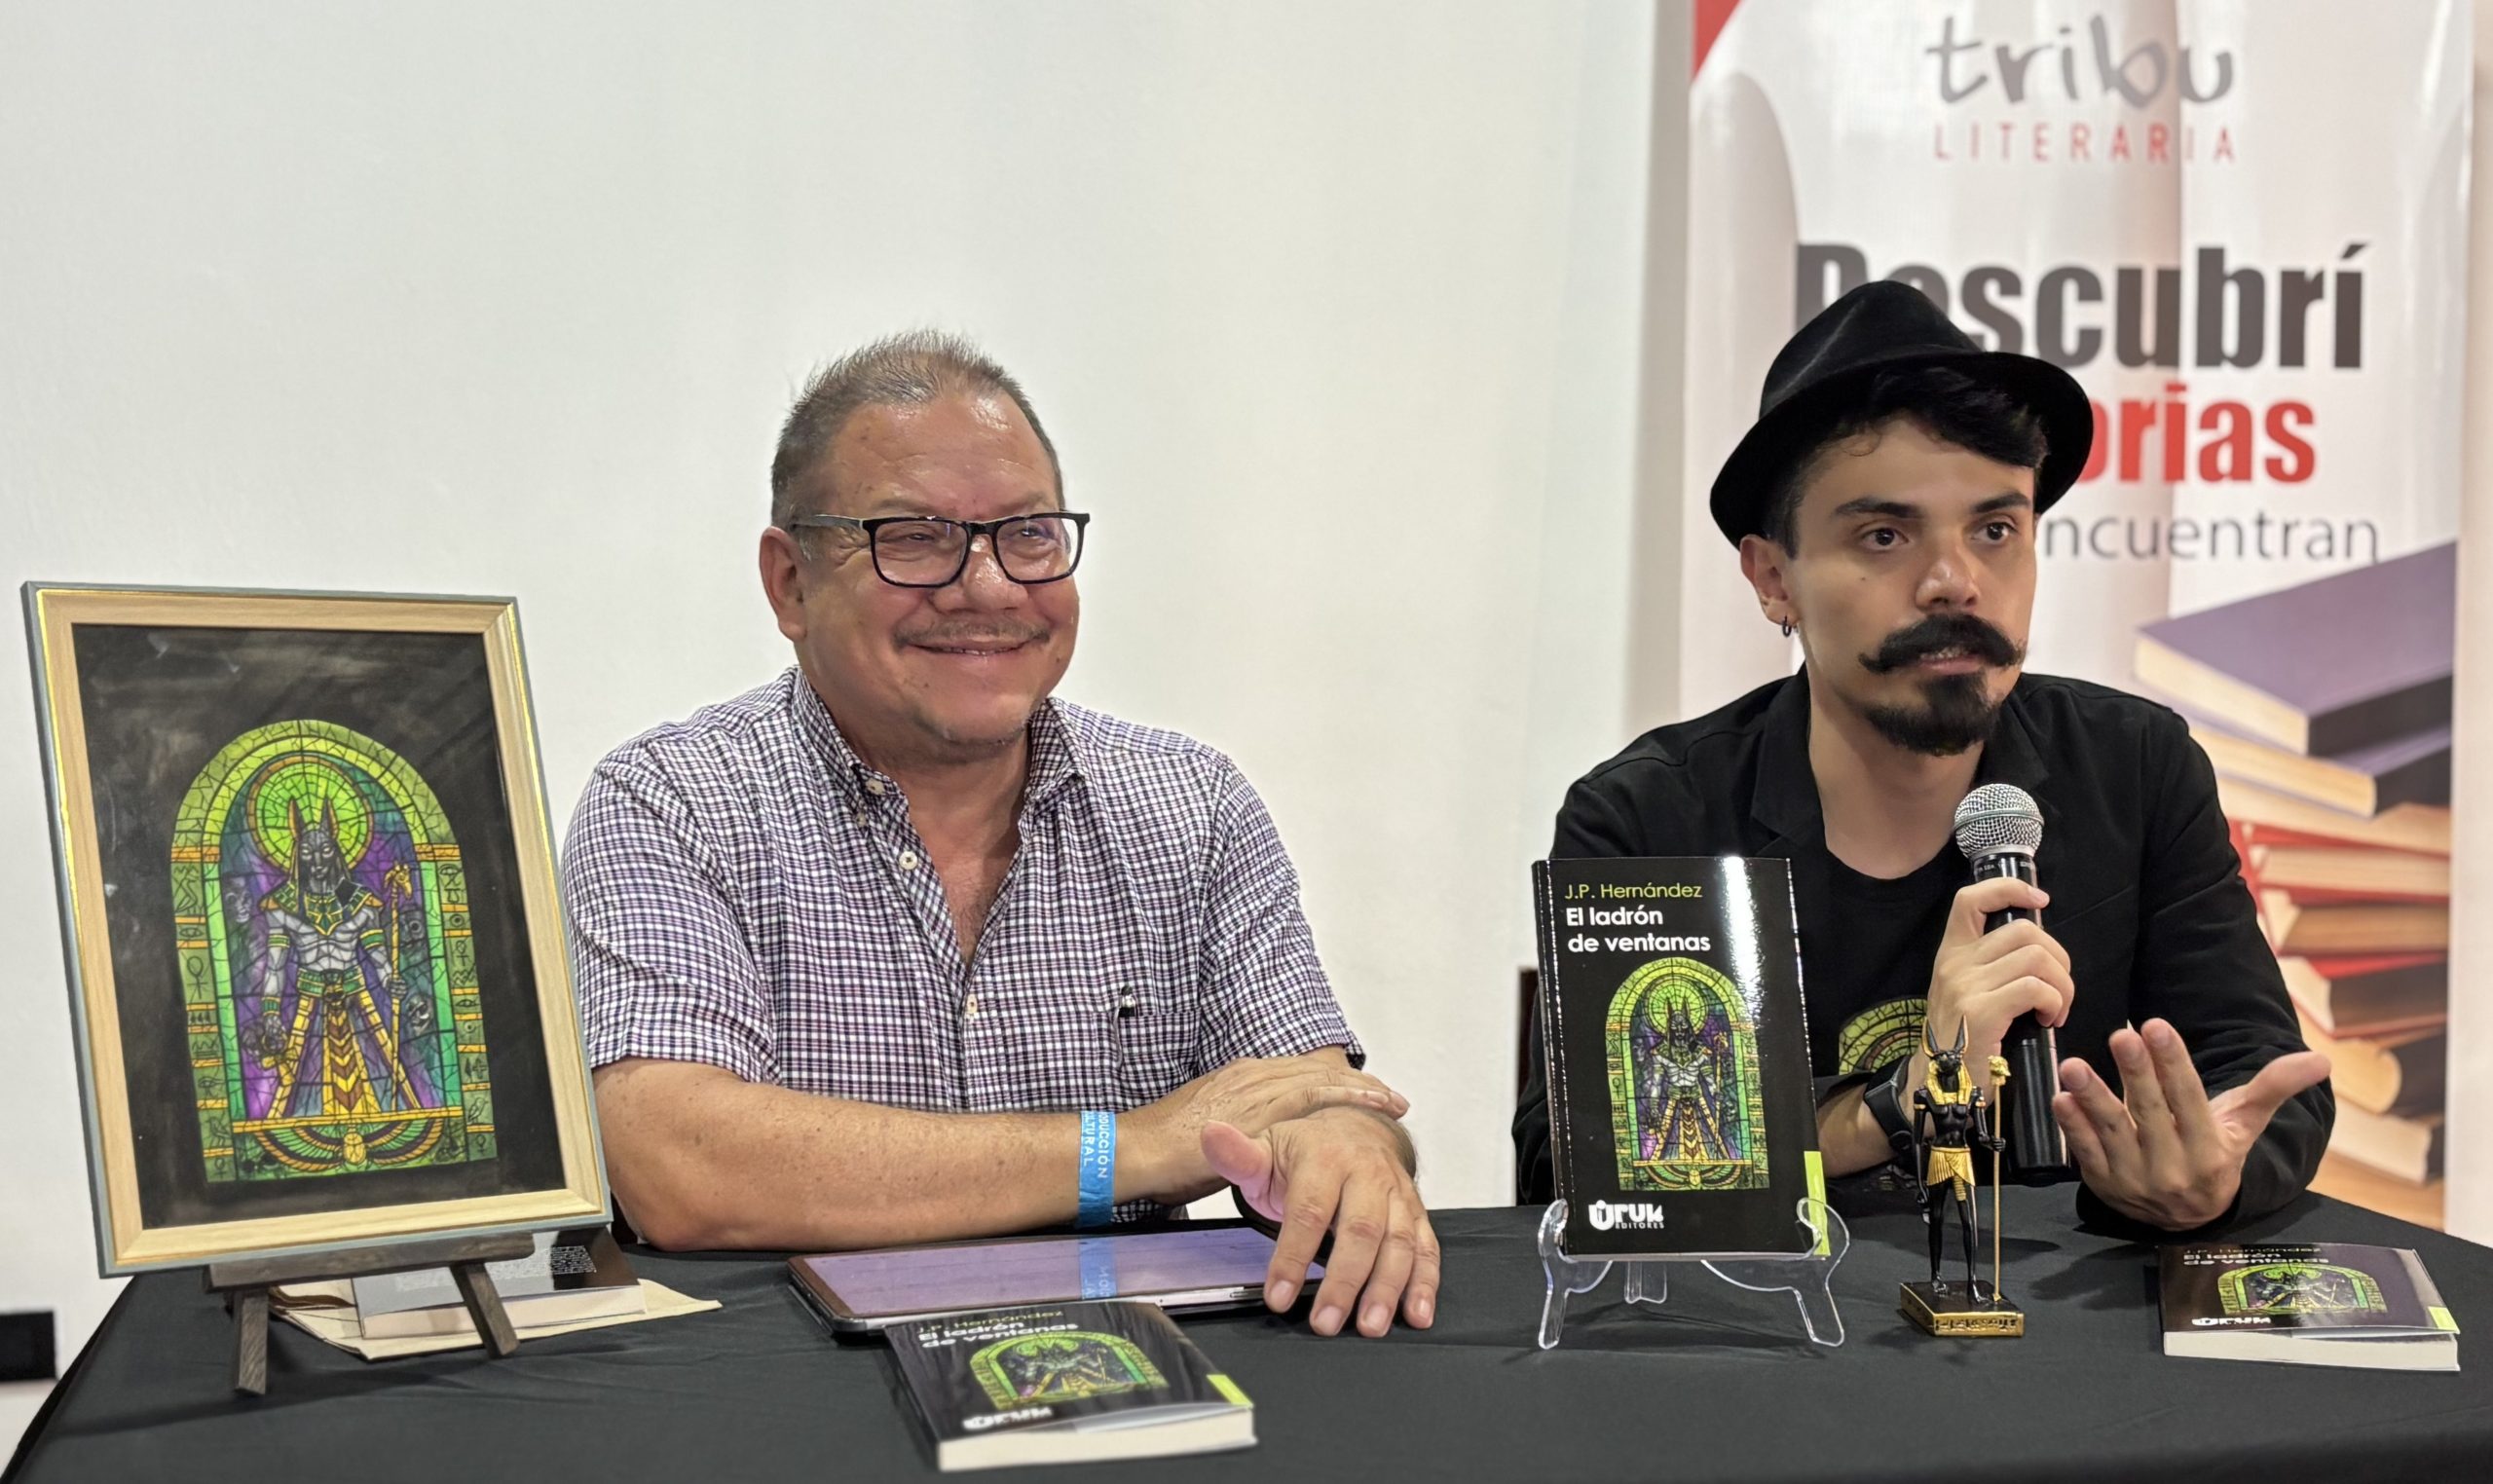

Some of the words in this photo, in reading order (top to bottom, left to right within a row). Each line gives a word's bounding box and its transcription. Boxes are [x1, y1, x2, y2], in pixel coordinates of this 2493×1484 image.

[1926, 15, 2233, 110] tribu
[1934, 123, 2235, 163] LITERARIA
[2045, 510, 2379, 562] ncuentran
[1564, 884, 1595, 899] J.P.
[1600, 882, 1703, 898] Hernández
[1566, 907, 1583, 926] El
[1589, 905, 1663, 925] ladrón
[1568, 933, 1599, 952] de
[1604, 932, 1711, 951] ventanas
